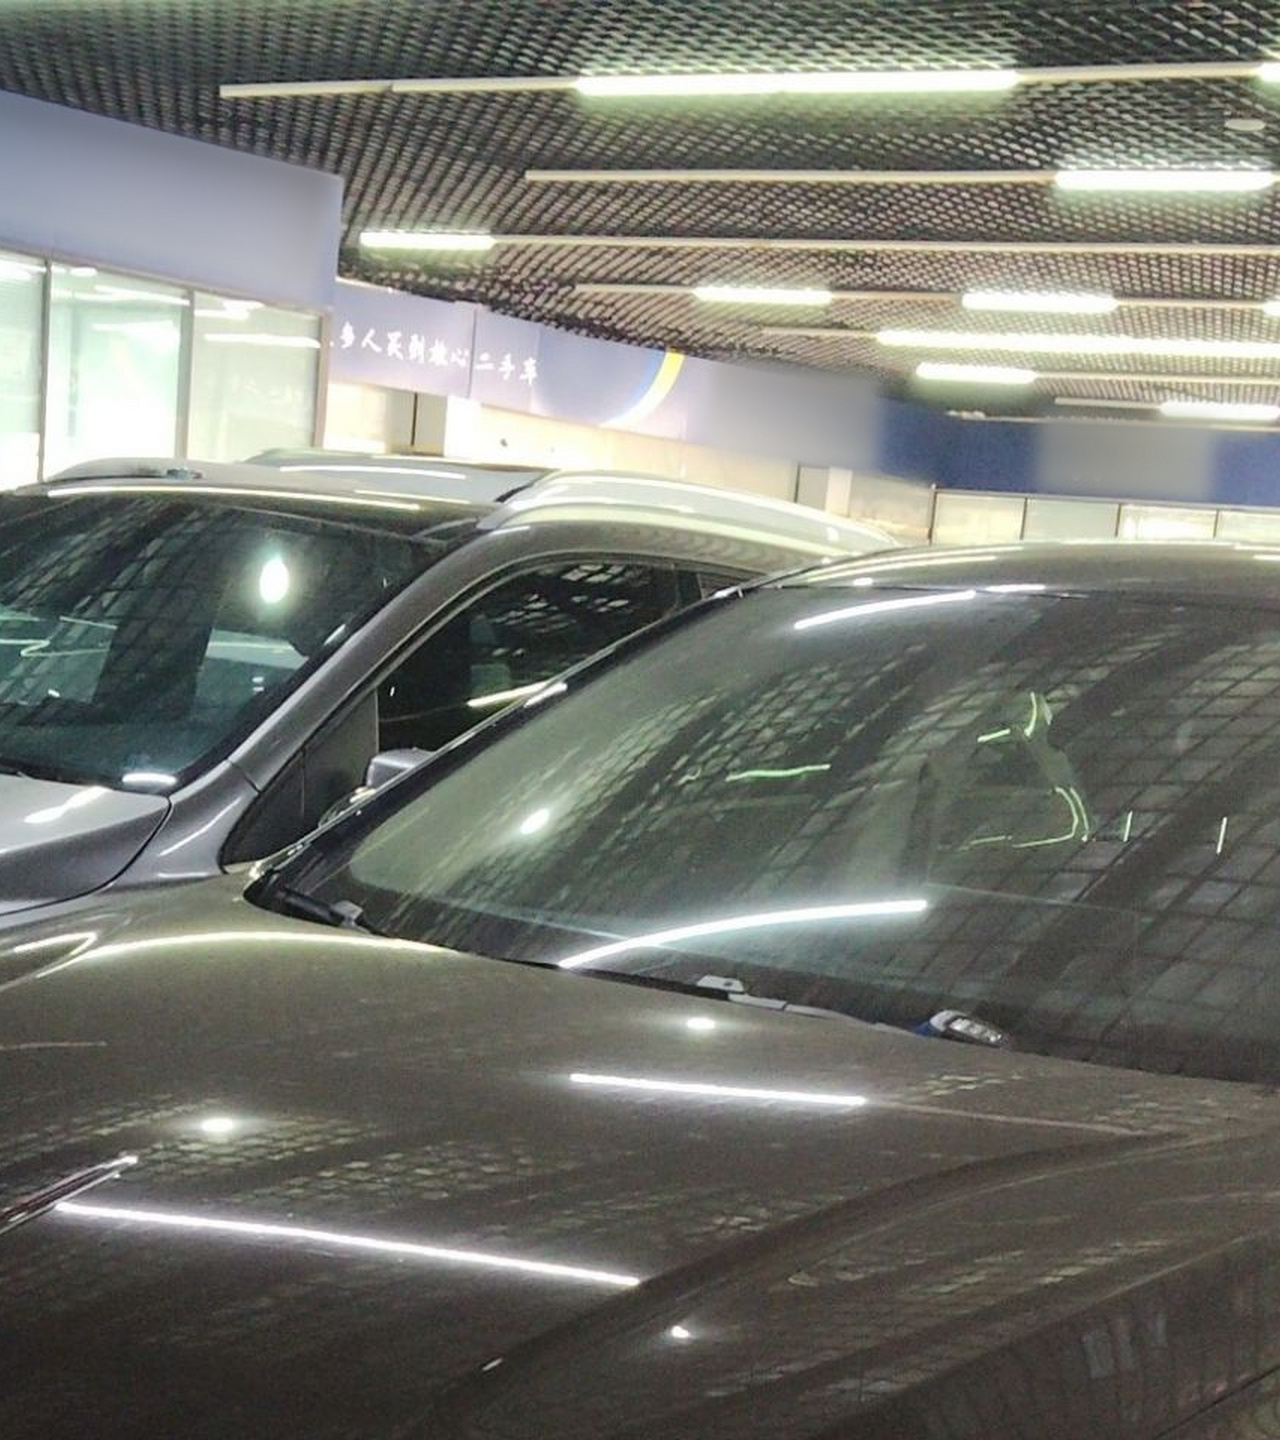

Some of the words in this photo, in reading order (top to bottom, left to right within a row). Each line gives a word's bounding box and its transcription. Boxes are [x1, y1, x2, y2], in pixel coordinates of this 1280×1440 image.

[329, 321, 538, 385] 多人买到放心二手车
